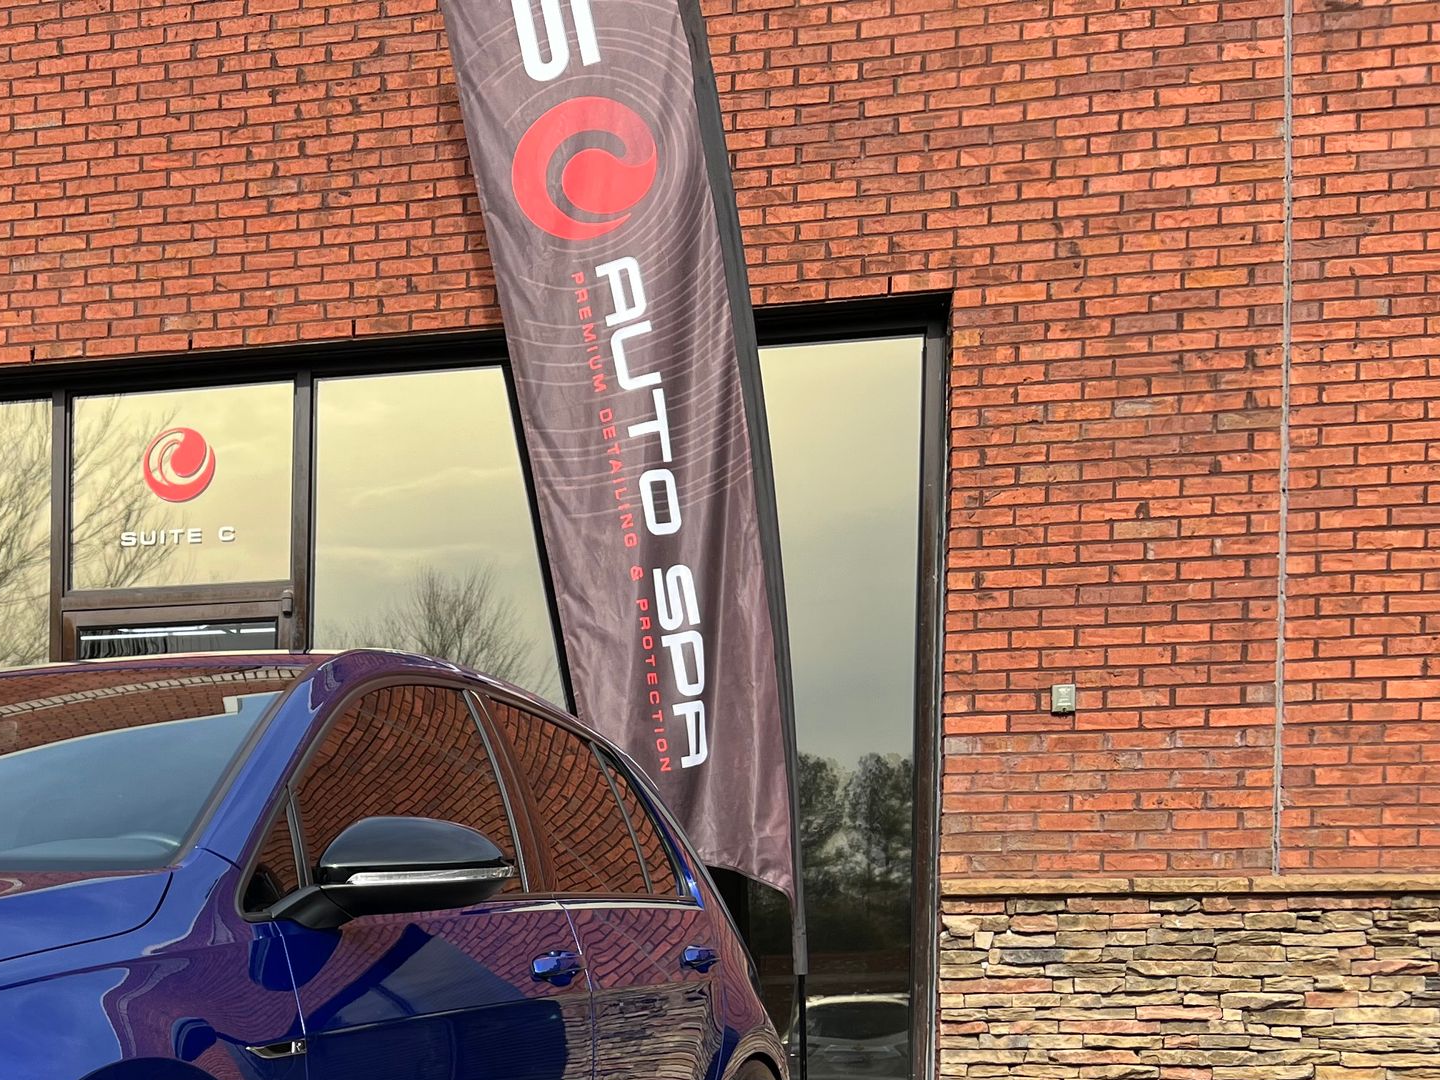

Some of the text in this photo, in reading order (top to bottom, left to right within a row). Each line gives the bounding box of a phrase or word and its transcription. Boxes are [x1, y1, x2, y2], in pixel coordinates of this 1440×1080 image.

[120, 526, 236, 547] SUITE C
[571, 271, 672, 772] PREMIUM DETAILING & PROTECTION
[595, 256, 709, 769] AUTO SPA
